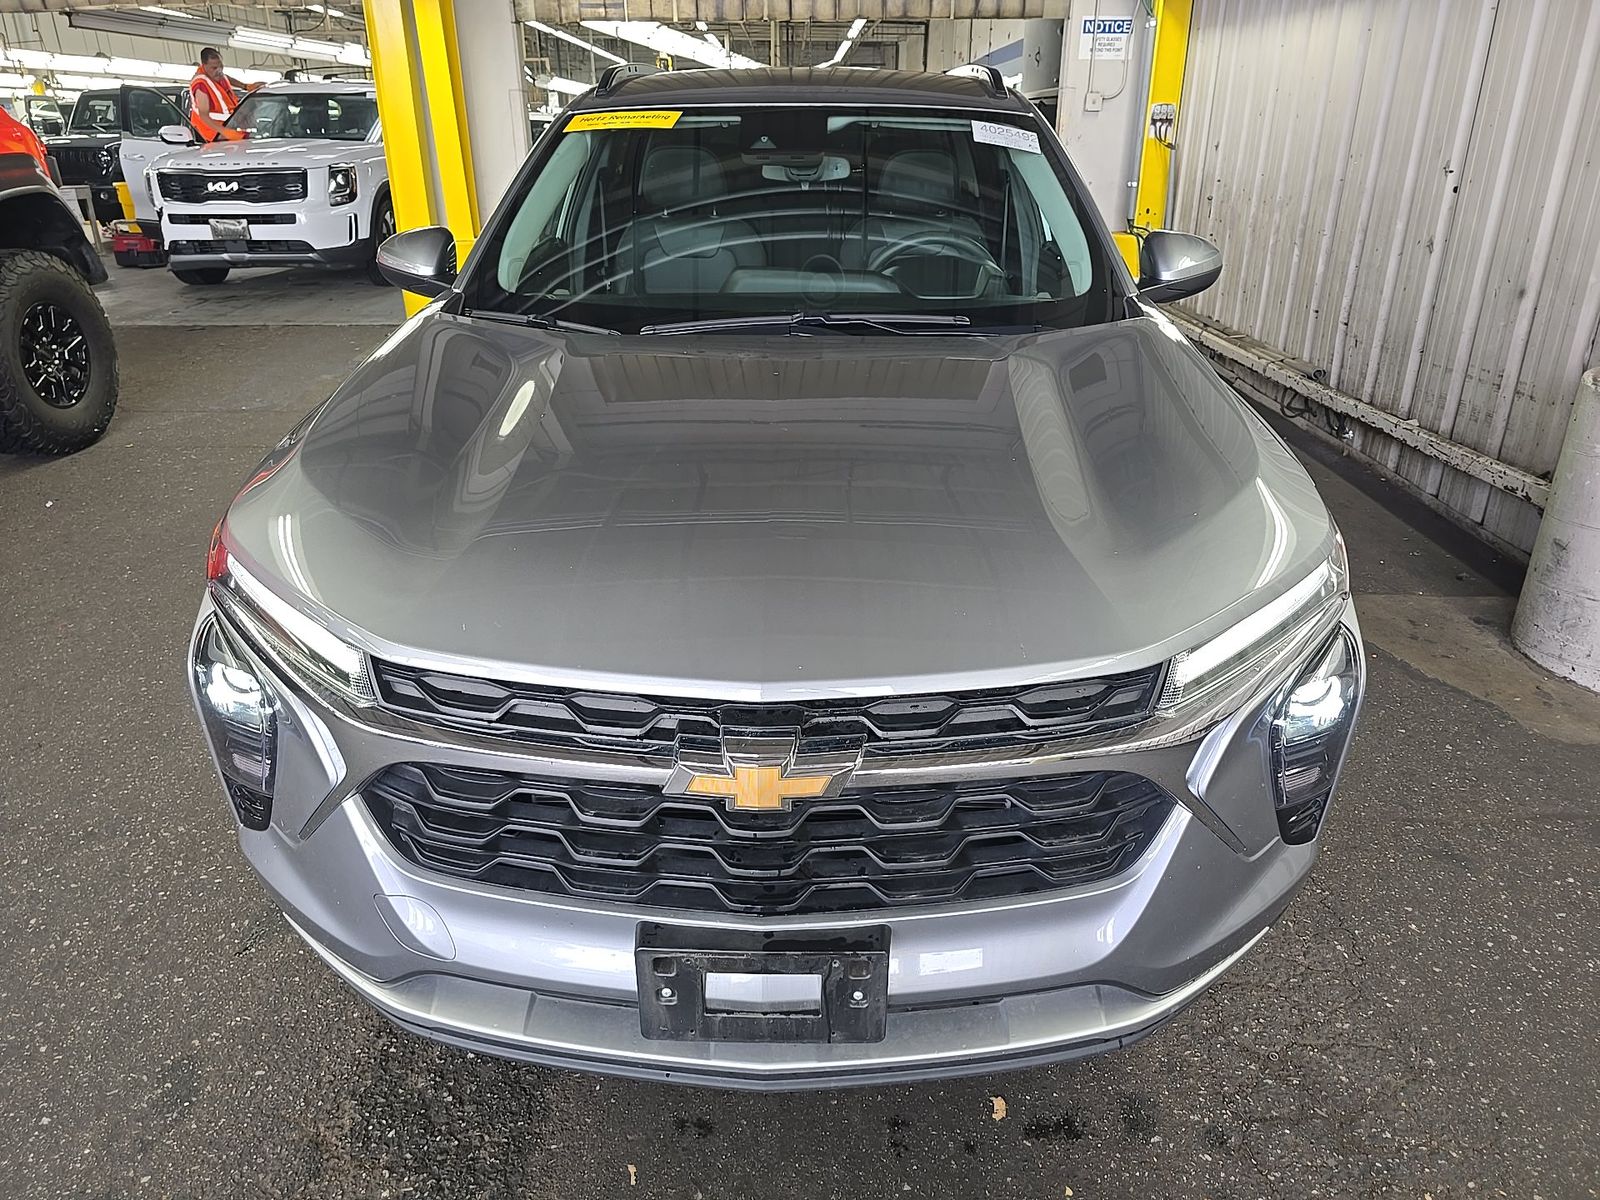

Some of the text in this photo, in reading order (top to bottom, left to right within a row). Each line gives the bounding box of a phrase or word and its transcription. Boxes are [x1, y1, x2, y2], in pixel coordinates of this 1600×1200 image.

[1085, 20, 1131, 32] NOTICE
[608, 113, 671, 121] Remarketing
[980, 124, 1037, 143] 4025492
[207, 181, 239, 192] KIA
